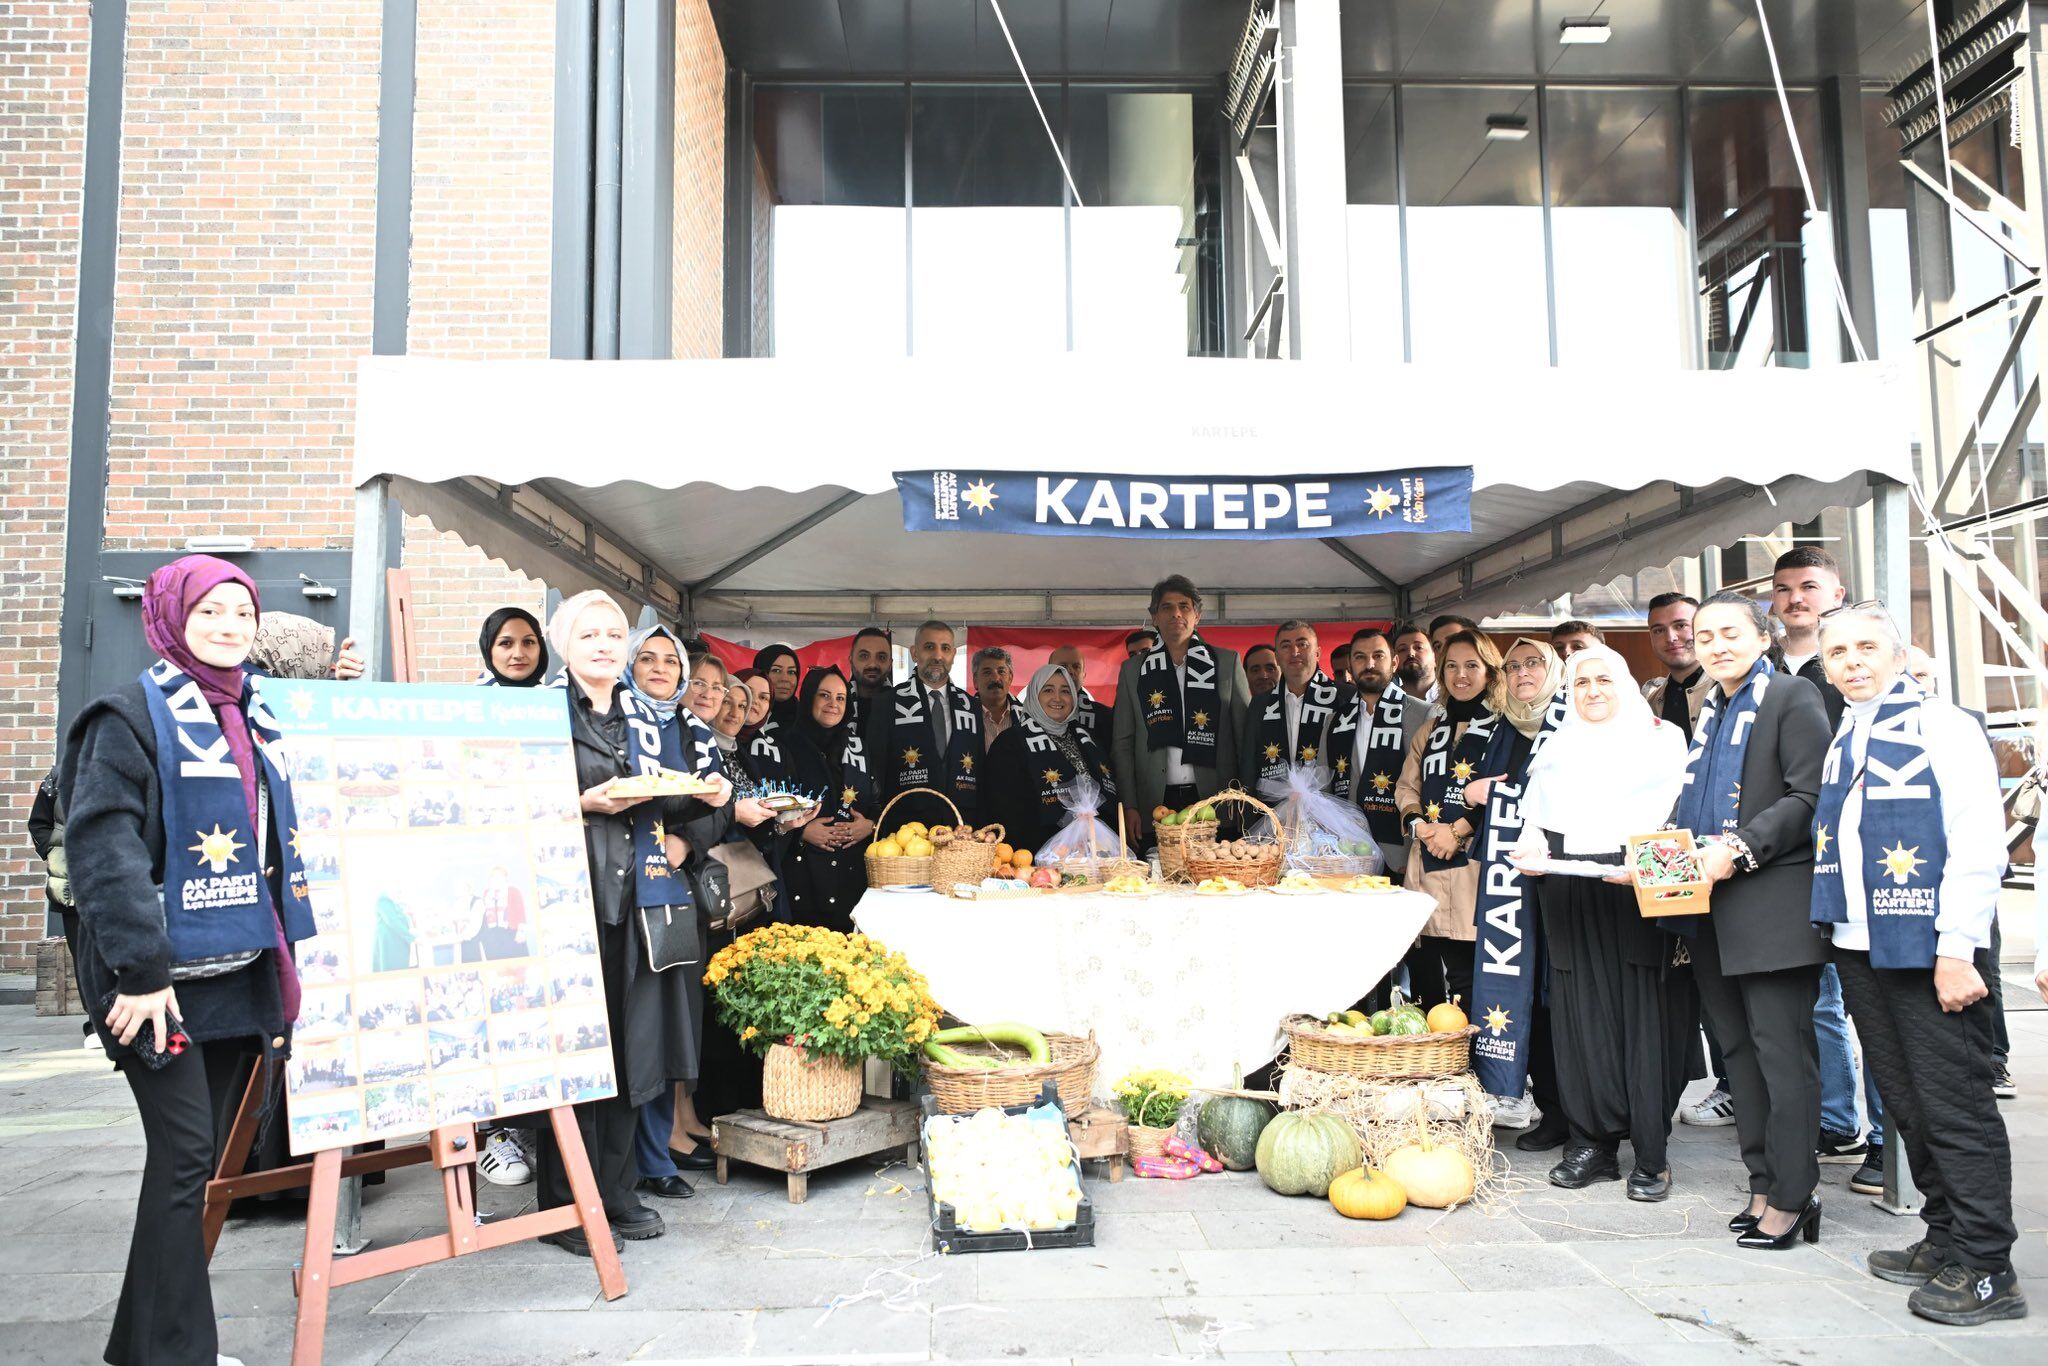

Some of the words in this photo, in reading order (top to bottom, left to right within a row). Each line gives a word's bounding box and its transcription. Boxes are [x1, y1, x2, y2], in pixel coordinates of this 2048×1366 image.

[949, 472, 958, 487] AK
[1035, 477, 1332, 530] KARTEPE
[1403, 508, 1412, 523] AK
[331, 696, 484, 722] KARTEPE
[900, 774, 928, 782] KARTEPE
[908, 768, 928, 776] PARTİ
[1722, 819, 1738, 828] AK
[646, 855, 660, 864] AK
[183, 879, 208, 891] AK
[210, 872, 257, 888] PARTİ
[290, 871, 303, 882] AK
[182, 885, 258, 901] KARTEPE
[1873, 888, 1890, 898] AK
[1893, 887, 1935, 899] PARTİ
[1873, 897, 1935, 909] KARTEPE
[1475, 1043, 1515, 1056] KARTEPE
[1477, 1036, 1488, 1045] AK
[1489, 1038, 1516, 1050] PARTİ
